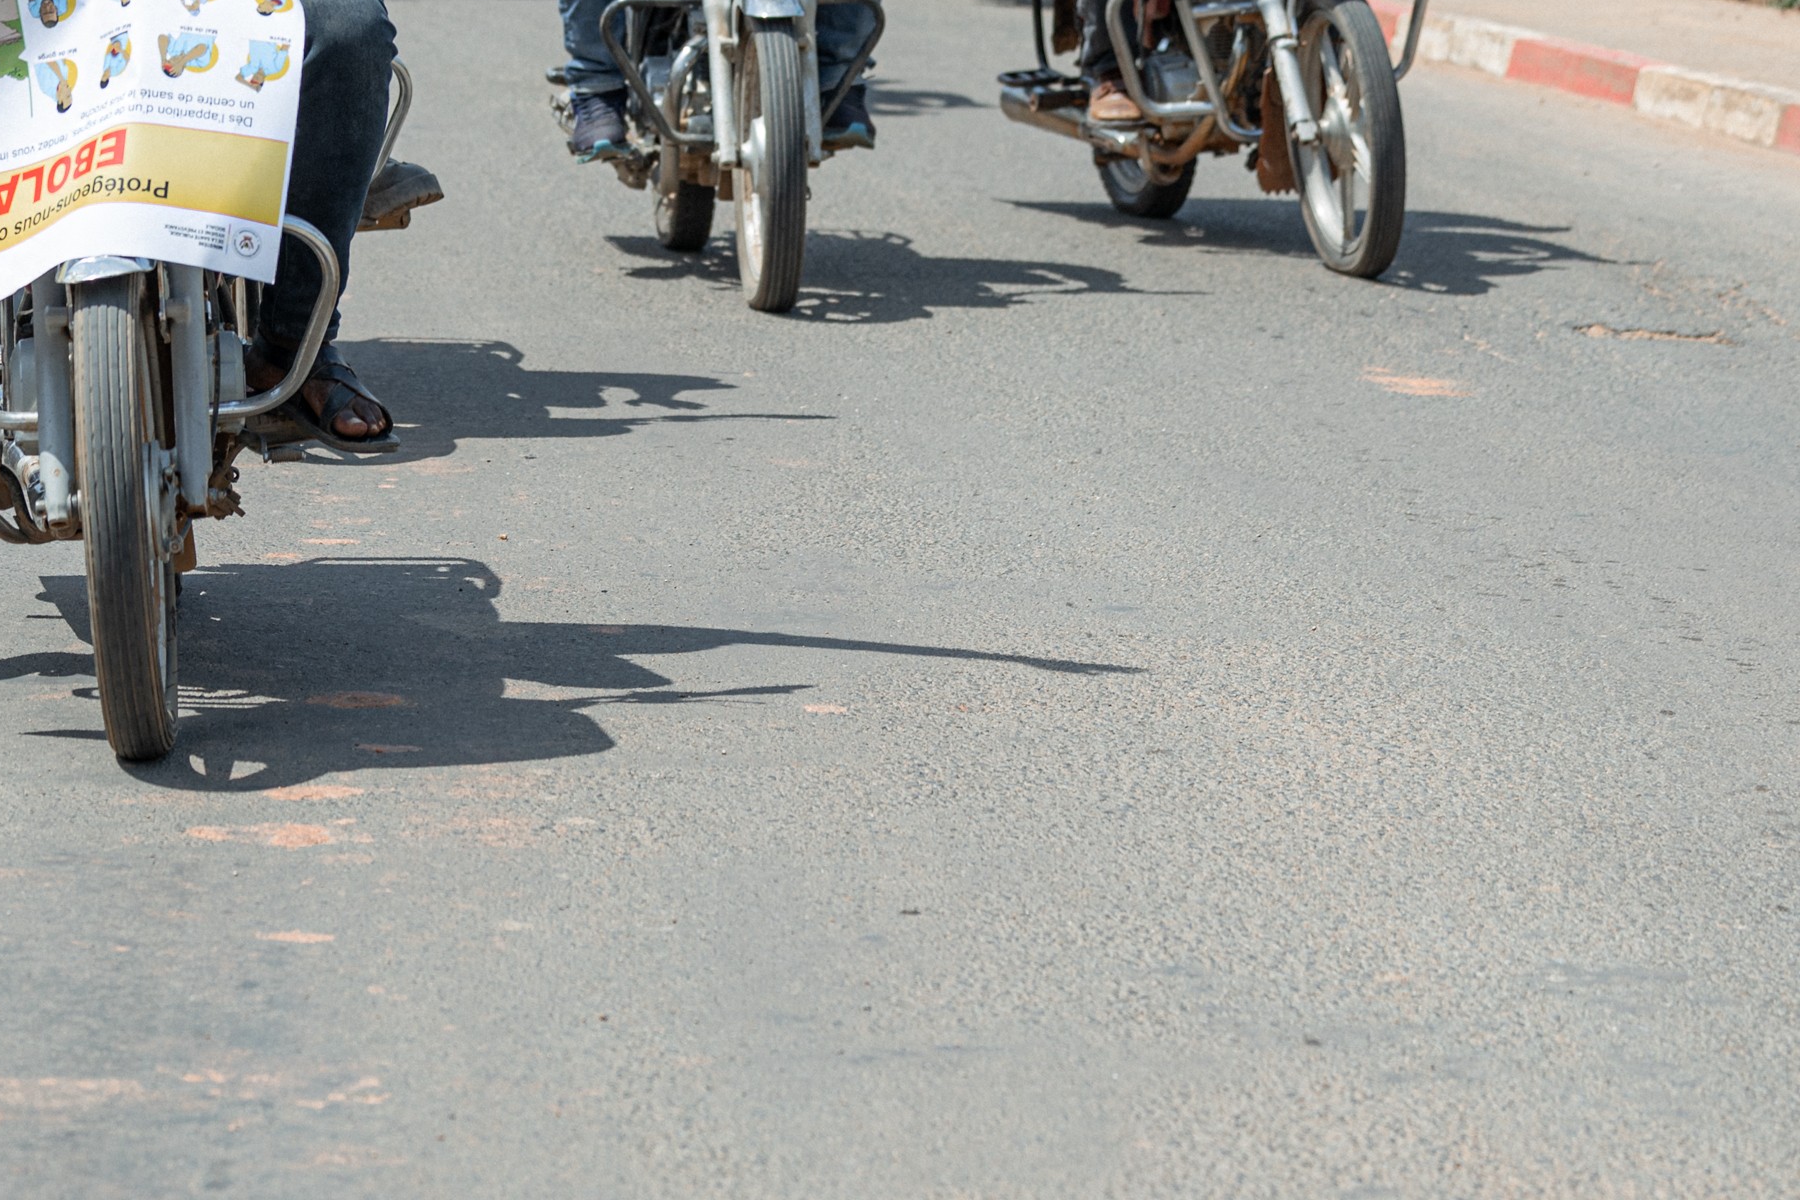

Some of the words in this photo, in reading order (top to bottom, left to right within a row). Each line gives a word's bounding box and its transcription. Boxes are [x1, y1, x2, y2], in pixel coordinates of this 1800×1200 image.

[37, 51, 57, 61] gorge
[140, 88, 174, 104] santé
[177, 93, 193, 106] de
[197, 95, 235, 108] centre
[128, 103, 154, 114] d'un
[239, 100, 255, 110] un
[157, 106, 225, 123] l'apparition
[229, 114, 253, 128] Dès
[38, 134, 68, 150] rendez
[12, 145, 35, 159] vous
[14, 175, 169, 236] Protégeons-nous
